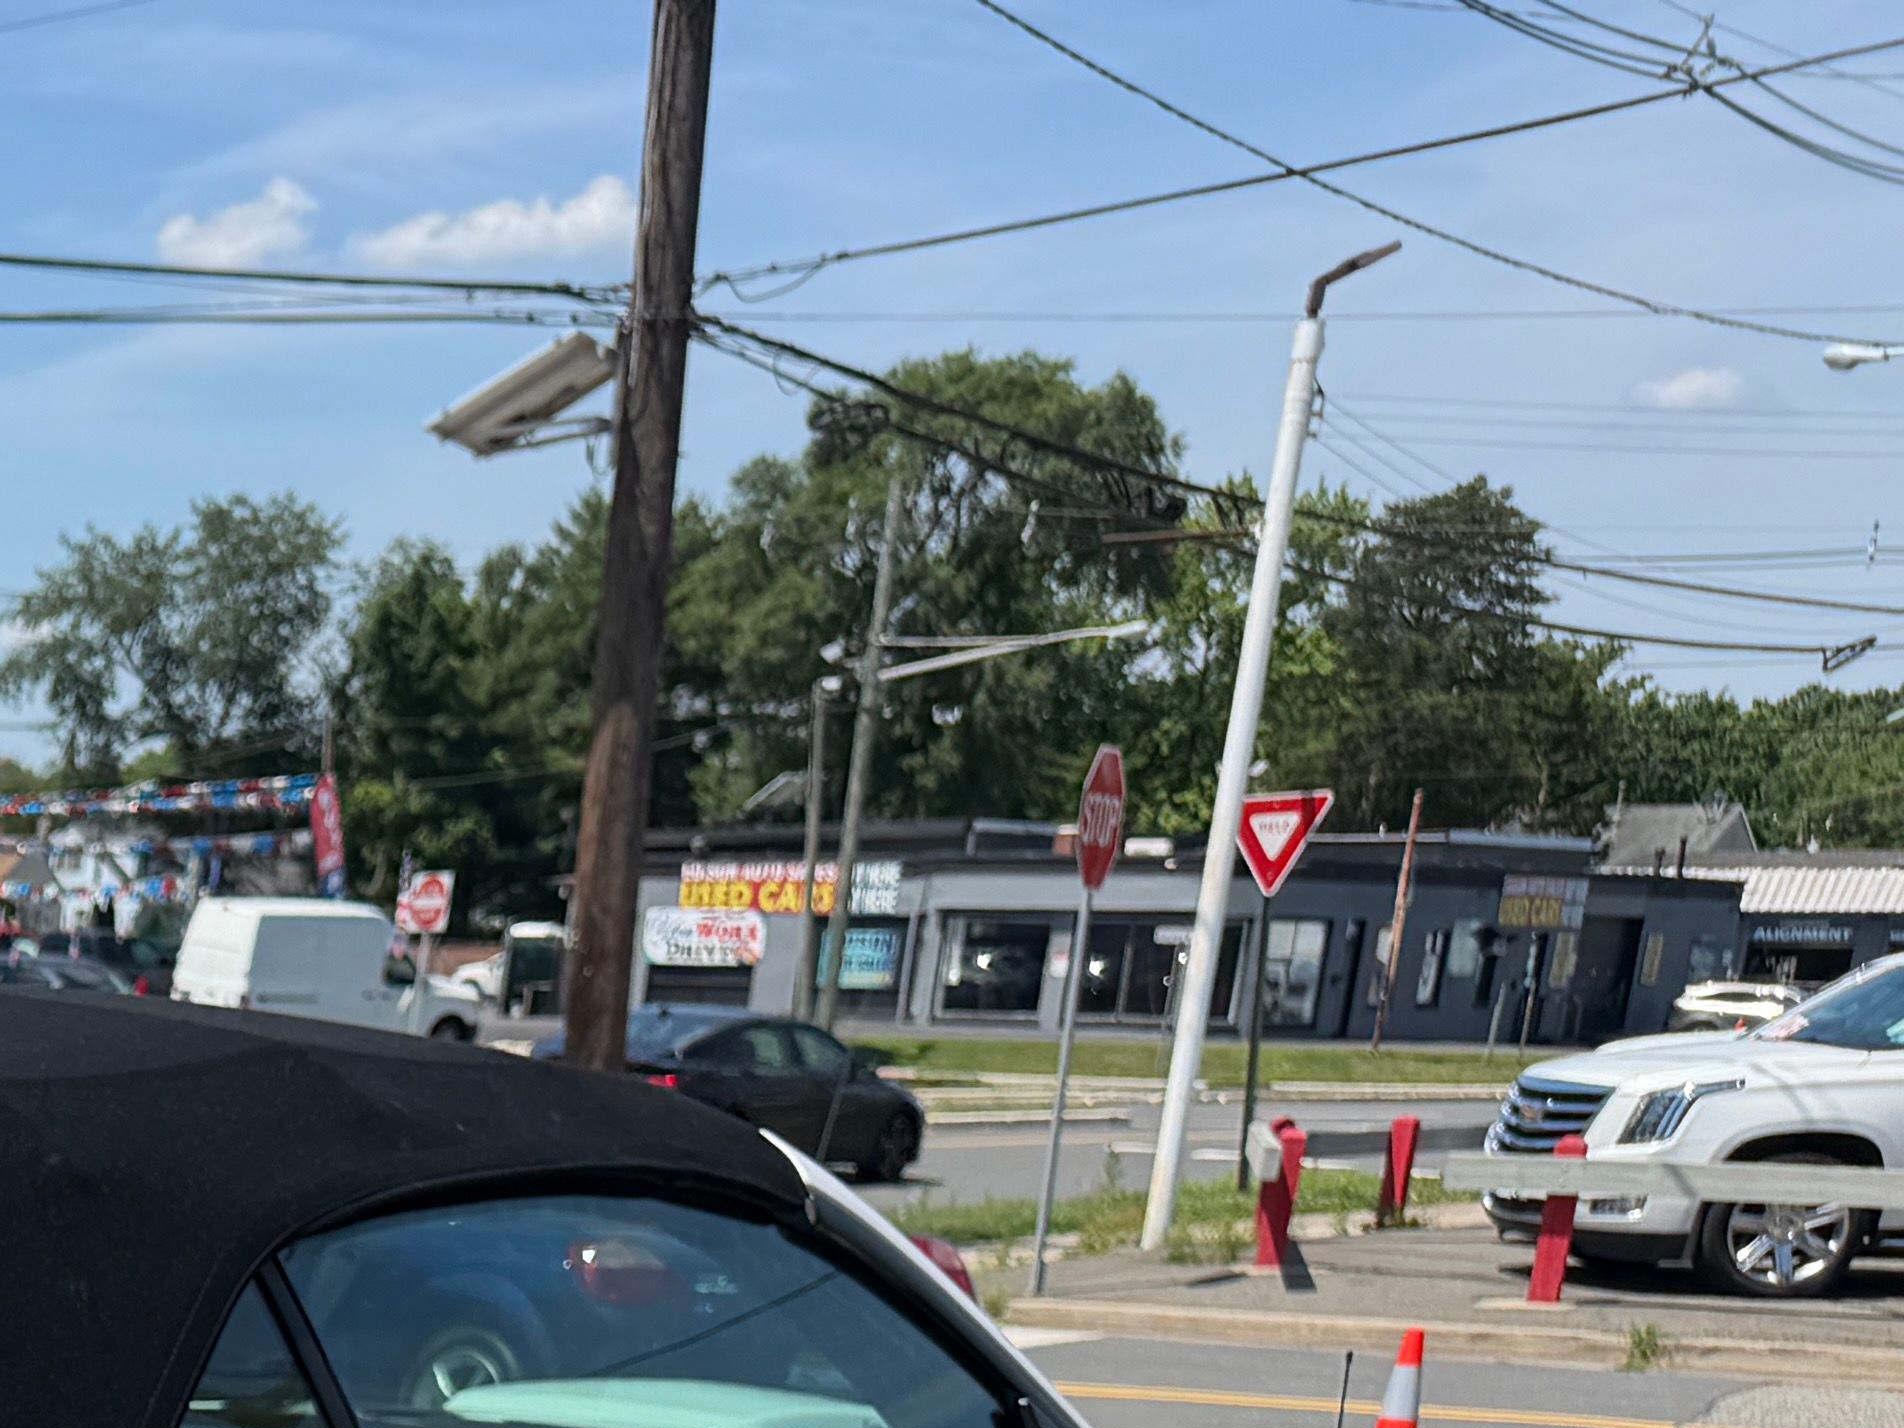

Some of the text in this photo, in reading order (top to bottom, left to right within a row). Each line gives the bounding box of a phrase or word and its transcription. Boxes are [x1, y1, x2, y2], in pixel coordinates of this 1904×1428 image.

[1082, 793, 1121, 848] STOP
[679, 880, 752, 908] USED
[1753, 925, 1856, 943] ALIGNMENT
